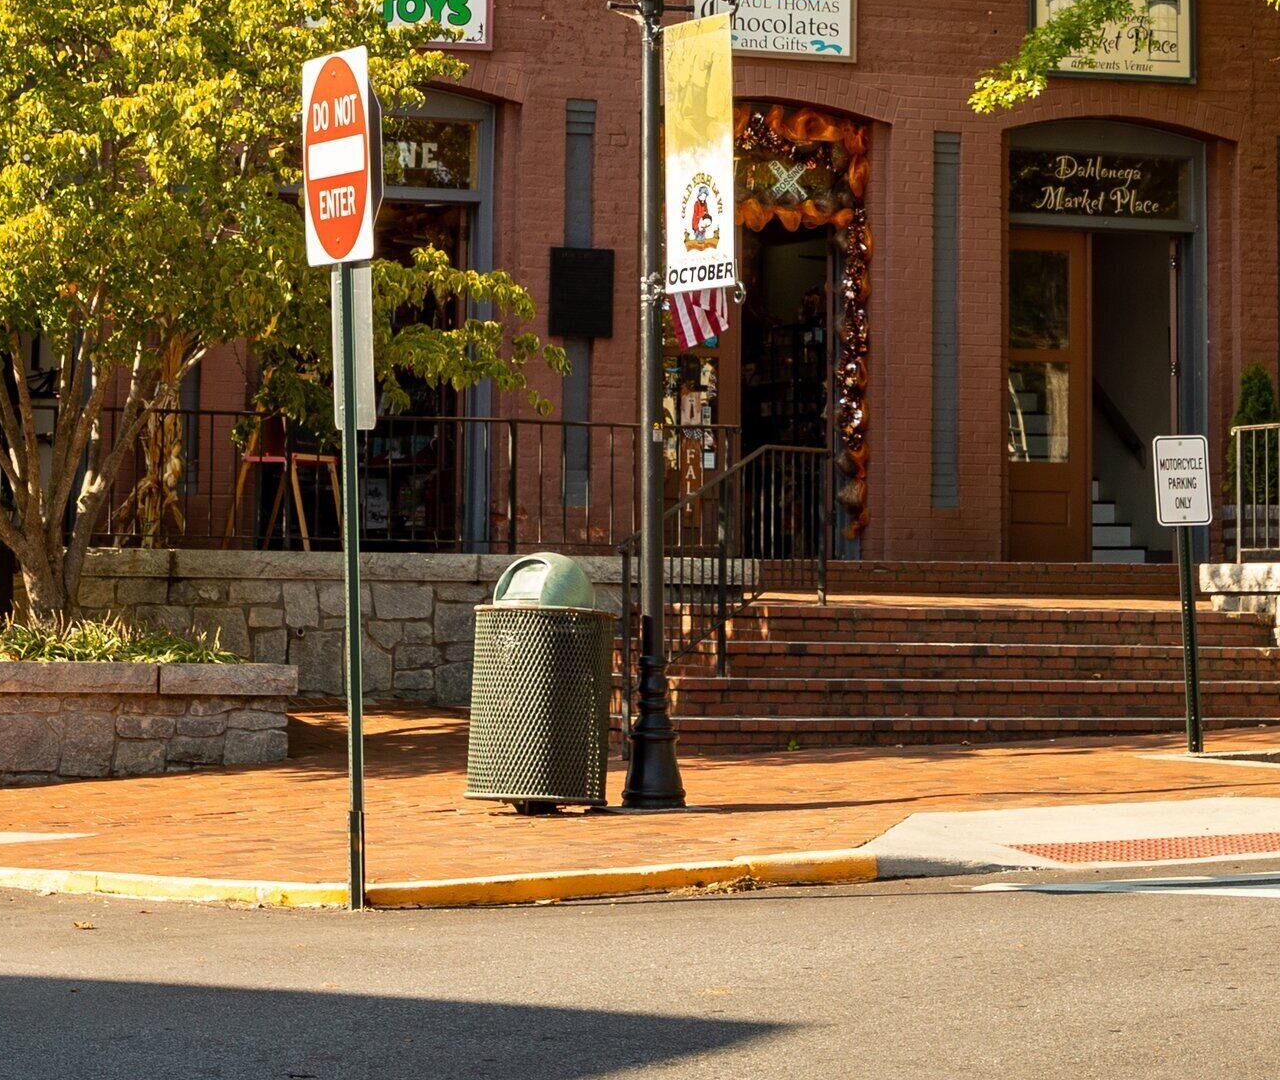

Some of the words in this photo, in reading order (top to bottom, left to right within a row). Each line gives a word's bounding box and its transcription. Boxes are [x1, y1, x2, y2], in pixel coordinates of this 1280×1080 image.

[732, 13, 840, 37] hocolates
[741, 35, 768, 49] and
[773, 36, 808, 51] Gifts
[1127, 26, 1178, 55] Place
[1124, 60, 1155, 72] Venue
[313, 100, 329, 132] DO
[334, 93, 357, 128] NOT
[1054, 155, 1141, 188] Dahlonega
[319, 185, 356, 221] ENTER
[1036, 186, 1105, 214] Market
[1109, 187, 1159, 214] Place
[668, 261, 733, 286] OCTOBER
[1160, 457, 1203, 470] MOTORCYCLE
[685, 449, 696, 512] FALL
[1168, 477, 1197, 489] PARKING
[1175, 497, 1192, 509] ONLY
